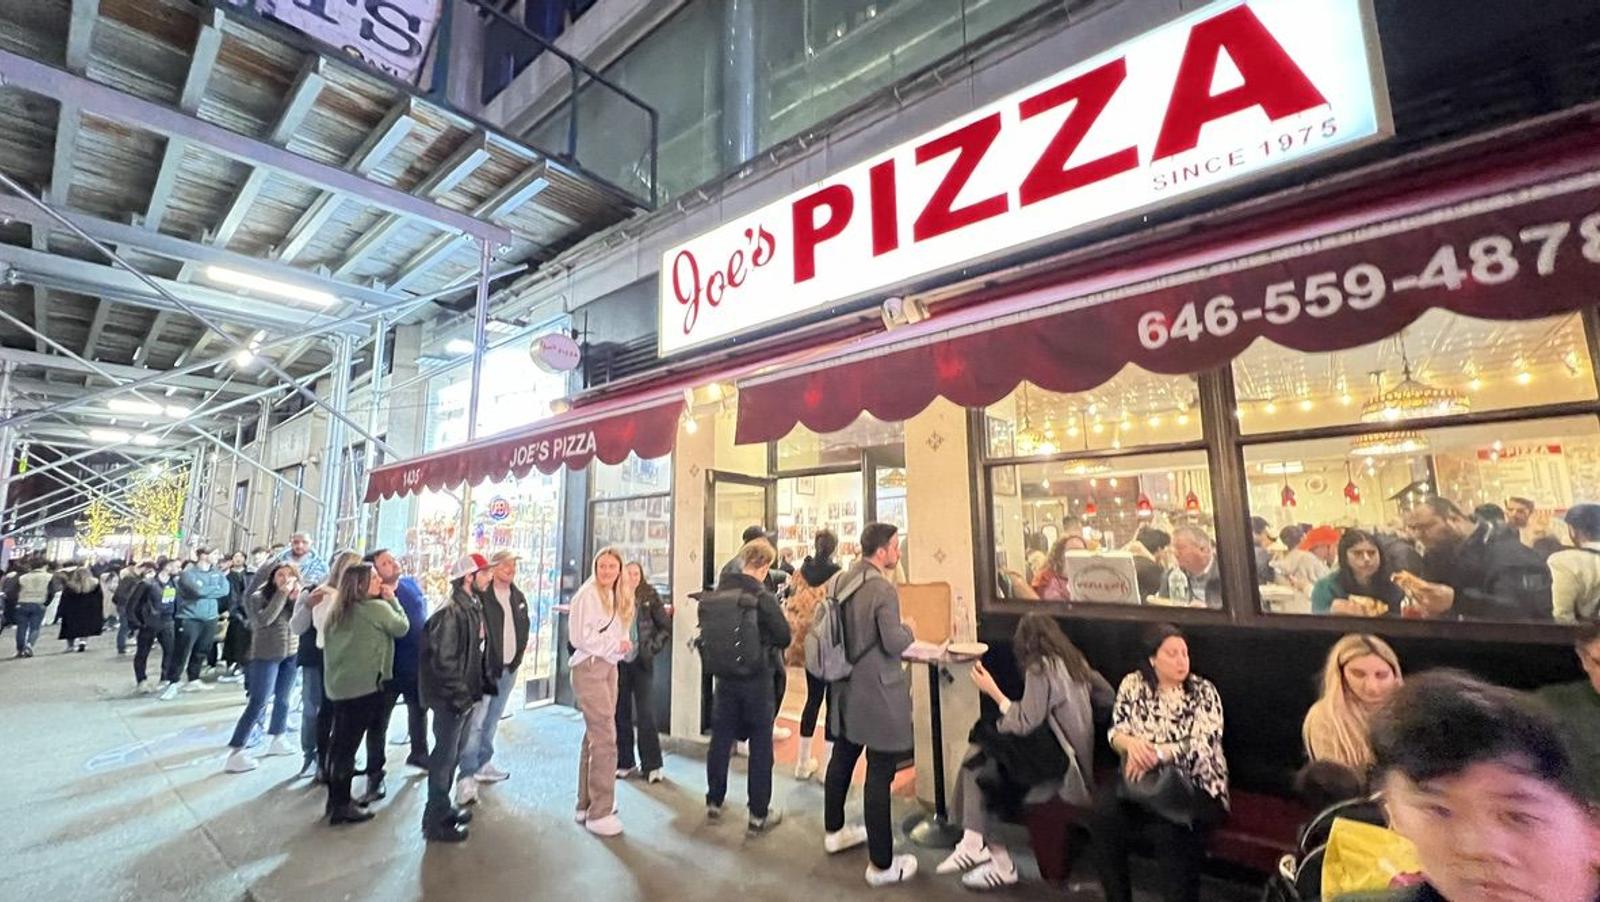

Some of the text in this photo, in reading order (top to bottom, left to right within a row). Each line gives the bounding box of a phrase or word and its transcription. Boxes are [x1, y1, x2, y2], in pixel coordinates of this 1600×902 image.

[672, 3, 1330, 335] Joe's PIZZA
[1153, 116, 1337, 191] SINCE 1975
[509, 431, 597, 468] JOE'S PIZZA
